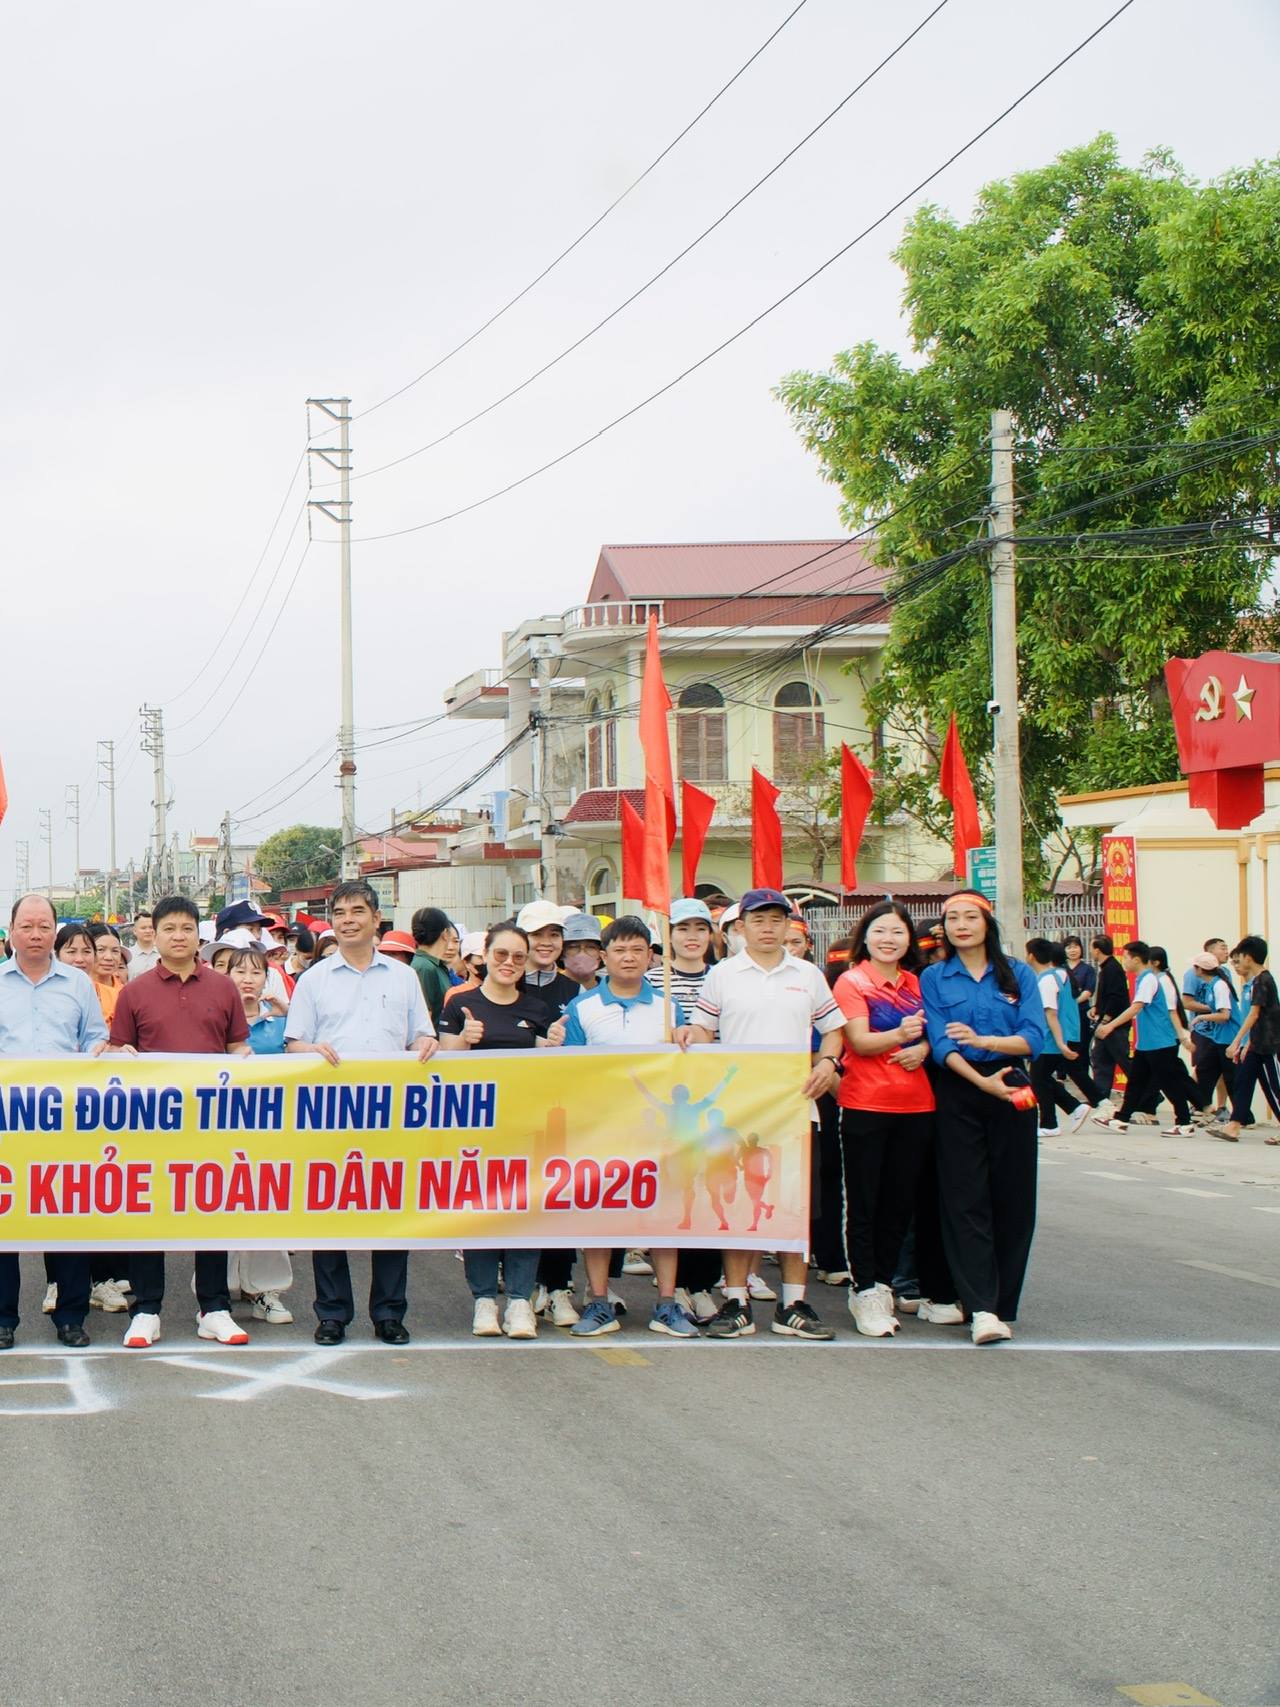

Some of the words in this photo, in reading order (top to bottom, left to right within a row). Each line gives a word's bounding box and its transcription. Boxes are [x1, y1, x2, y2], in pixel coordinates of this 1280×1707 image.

[75, 1076, 183, 1131] ĐÔNG
[196, 1071, 284, 1130] TỈNH
[296, 1085, 392, 1130] NINH
[404, 1075, 496, 1129] BÌNH
[30, 1146, 151, 1213] KHỎE
[169, 1152, 291, 1212] TOÀN
[307, 1150, 403, 1210] DÂN
[419, 1148, 527, 1210] NĂM
[545, 1159, 657, 1209] 2026
